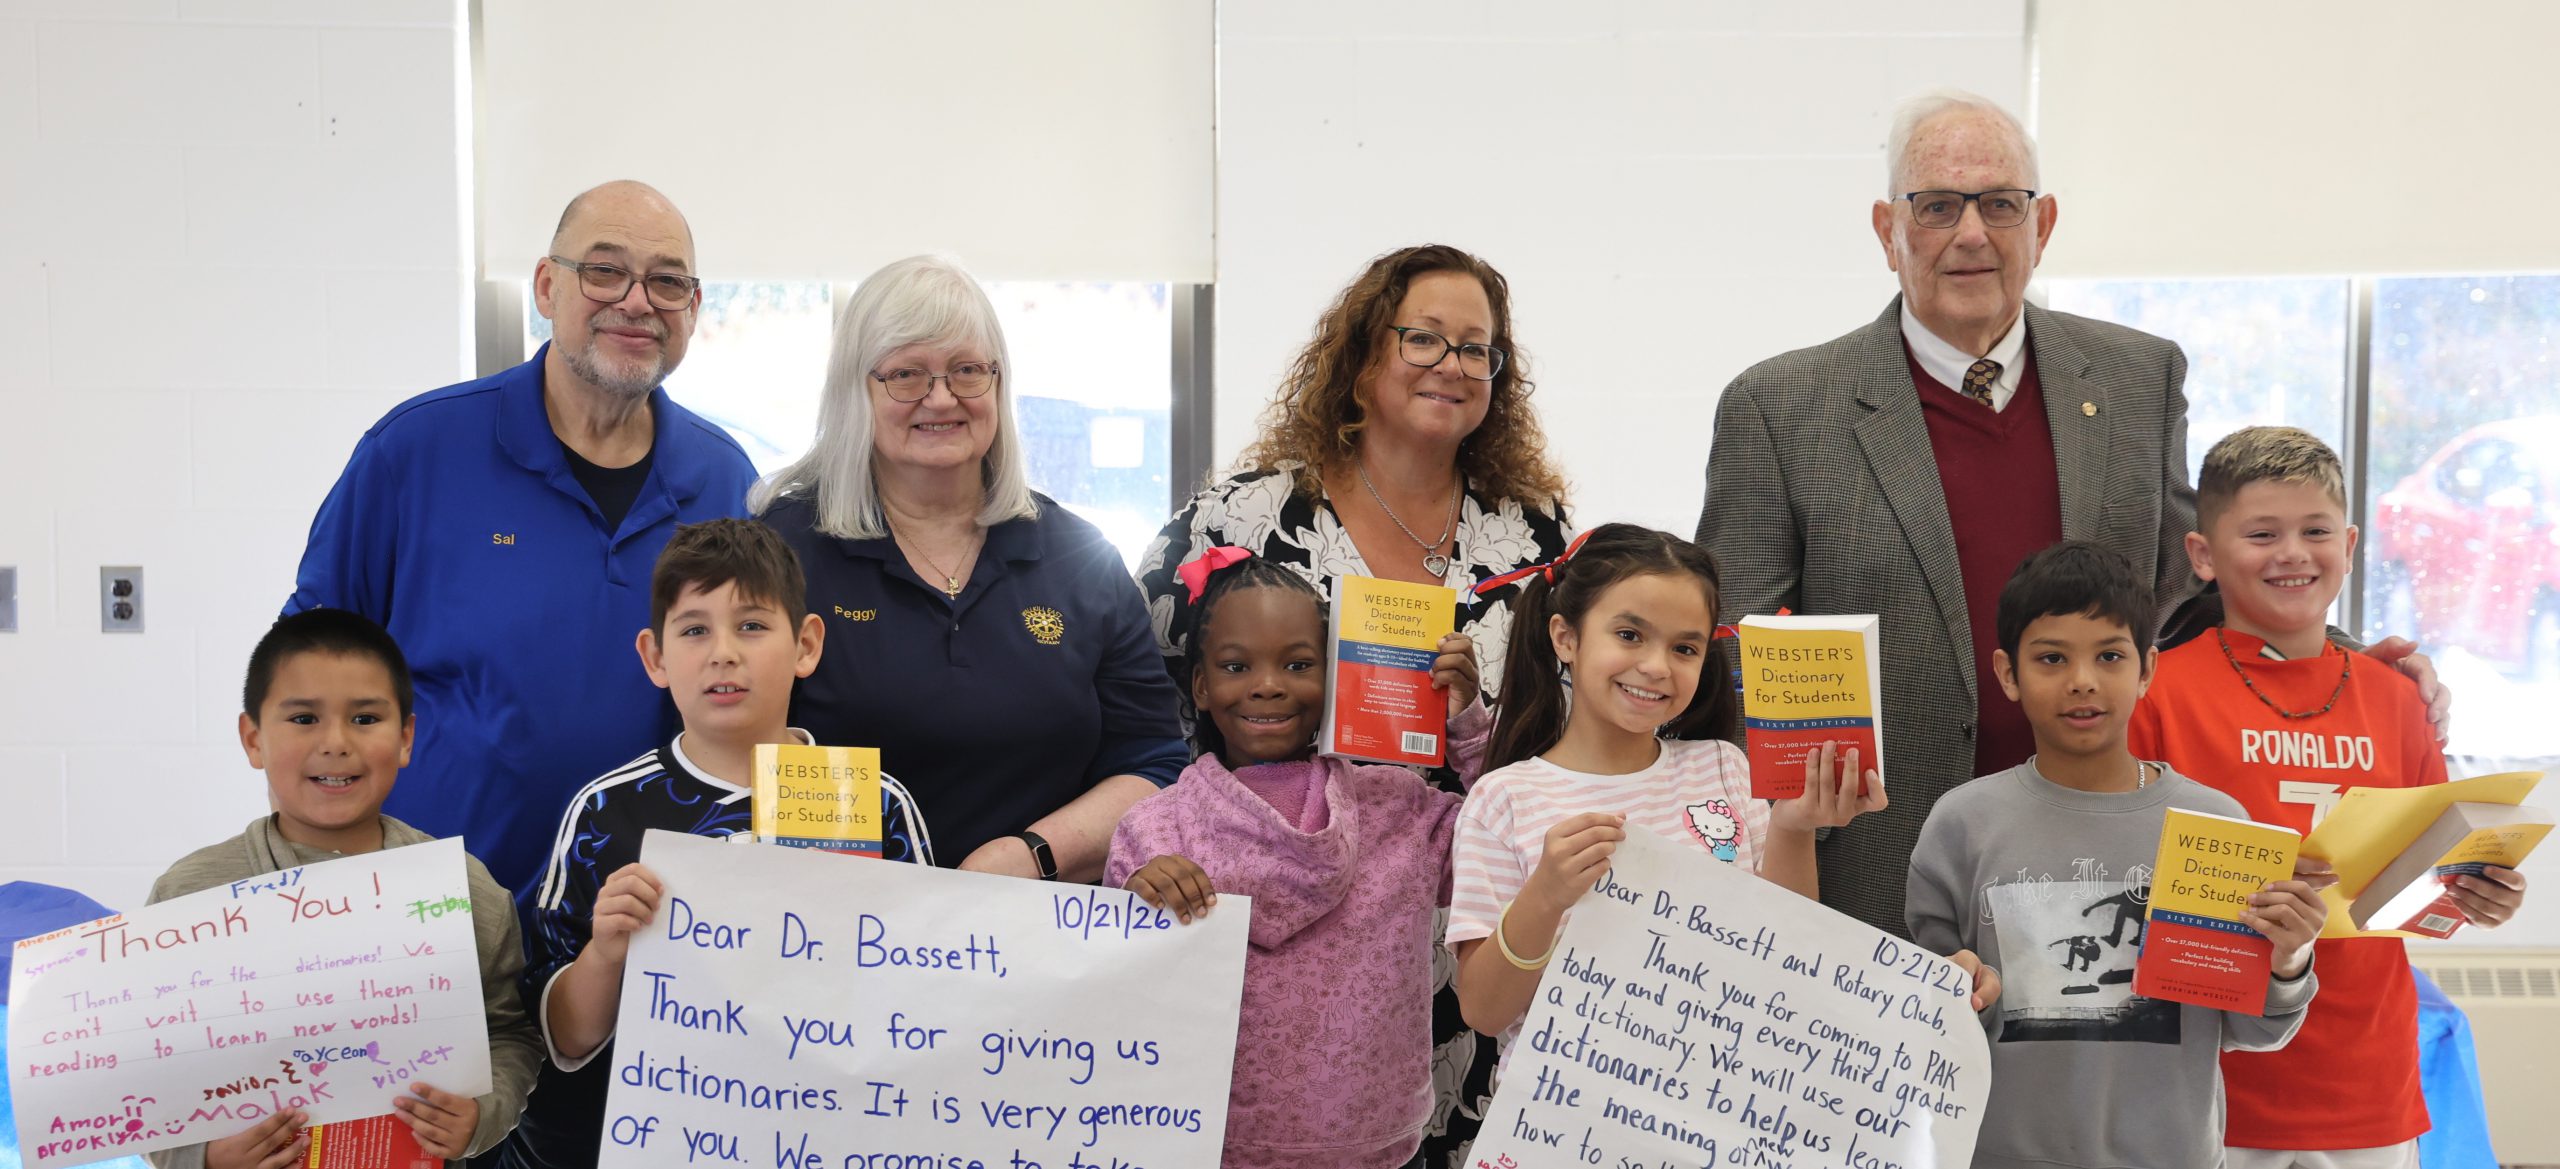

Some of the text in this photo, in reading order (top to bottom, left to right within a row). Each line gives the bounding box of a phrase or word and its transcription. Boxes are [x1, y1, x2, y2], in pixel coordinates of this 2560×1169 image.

[493, 533, 515, 545] Sal
[834, 605, 877, 621] Peggy
[1364, 593, 1430, 611] WEBSTER'S
[1371, 608, 1423, 626] Dictionary
[1364, 622, 1426, 638] for Students
[1749, 644, 1853, 661] WEBSTER'S
[1762, 668, 1844, 686] Dictionary
[1755, 689, 1855, 704] for Students
[1804, 719, 1856, 727] EDITION
[2241, 728, 2375, 771] RONALDO
[767, 764, 869, 780] WEBSTER'S
[779, 785, 859, 807] Dictionary
[771, 806, 867, 824] for Students
[780, 839, 866, 849] IXTH EDITION
[2179, 833, 2284, 865] WEBSTER'S
[2184, 858, 2268, 890] Dictionary
[2171, 880, 2250, 906] for Stude
[81, 905, 249, 963] Thank
[277, 887, 352, 922] You
[1053, 888, 1174, 939] 10/21/26
[2167, 914, 2256, 935] SIXTH EDITIO
[667, 896, 1010, 979] Dear Dr. Bassett,
[1594, 866, 1948, 1038] Dear Dr. Bassett and Rotary Club,
[2179, 939, 2199, 947] 37,000
[2200, 943, 2230, 953] kid-friendly
[2231, 948, 2258, 957] definitions
[2185, 952, 2203, 960] Perfect
[2213, 957, 2234, 966] building
[2208, 964, 2228, 973] reading
[64, 941, 435, 1012] Thank you for the dictionaries! We
[43, 973, 451, 1045] can't wait to use them in
[1643, 929, 1962, 1092] Thank you for coming to PAK
[29, 1003, 419, 1078] reading to learn new words!
[643, 970, 1160, 1084] Thank you for giving us
[1563, 948, 1967, 1120] today and giving every third grader
[1547, 985, 1911, 1138] a dictionary. We will use our
[621, 1049, 1201, 1147] dictionaries. It is very generous
[1530, 1017, 1690, 1101] dictionaries
[1706, 1079, 1732, 1114] to
[1740, 1093, 1797, 1151] help
[1803, 1129, 1832, 1152] us
[1532, 1065, 1795, 1168] the meaning of new
[683, 1126, 749, 1163] you.
[776, 1130, 822, 1169] We
[1513, 1108, 1602, 1165] how to
